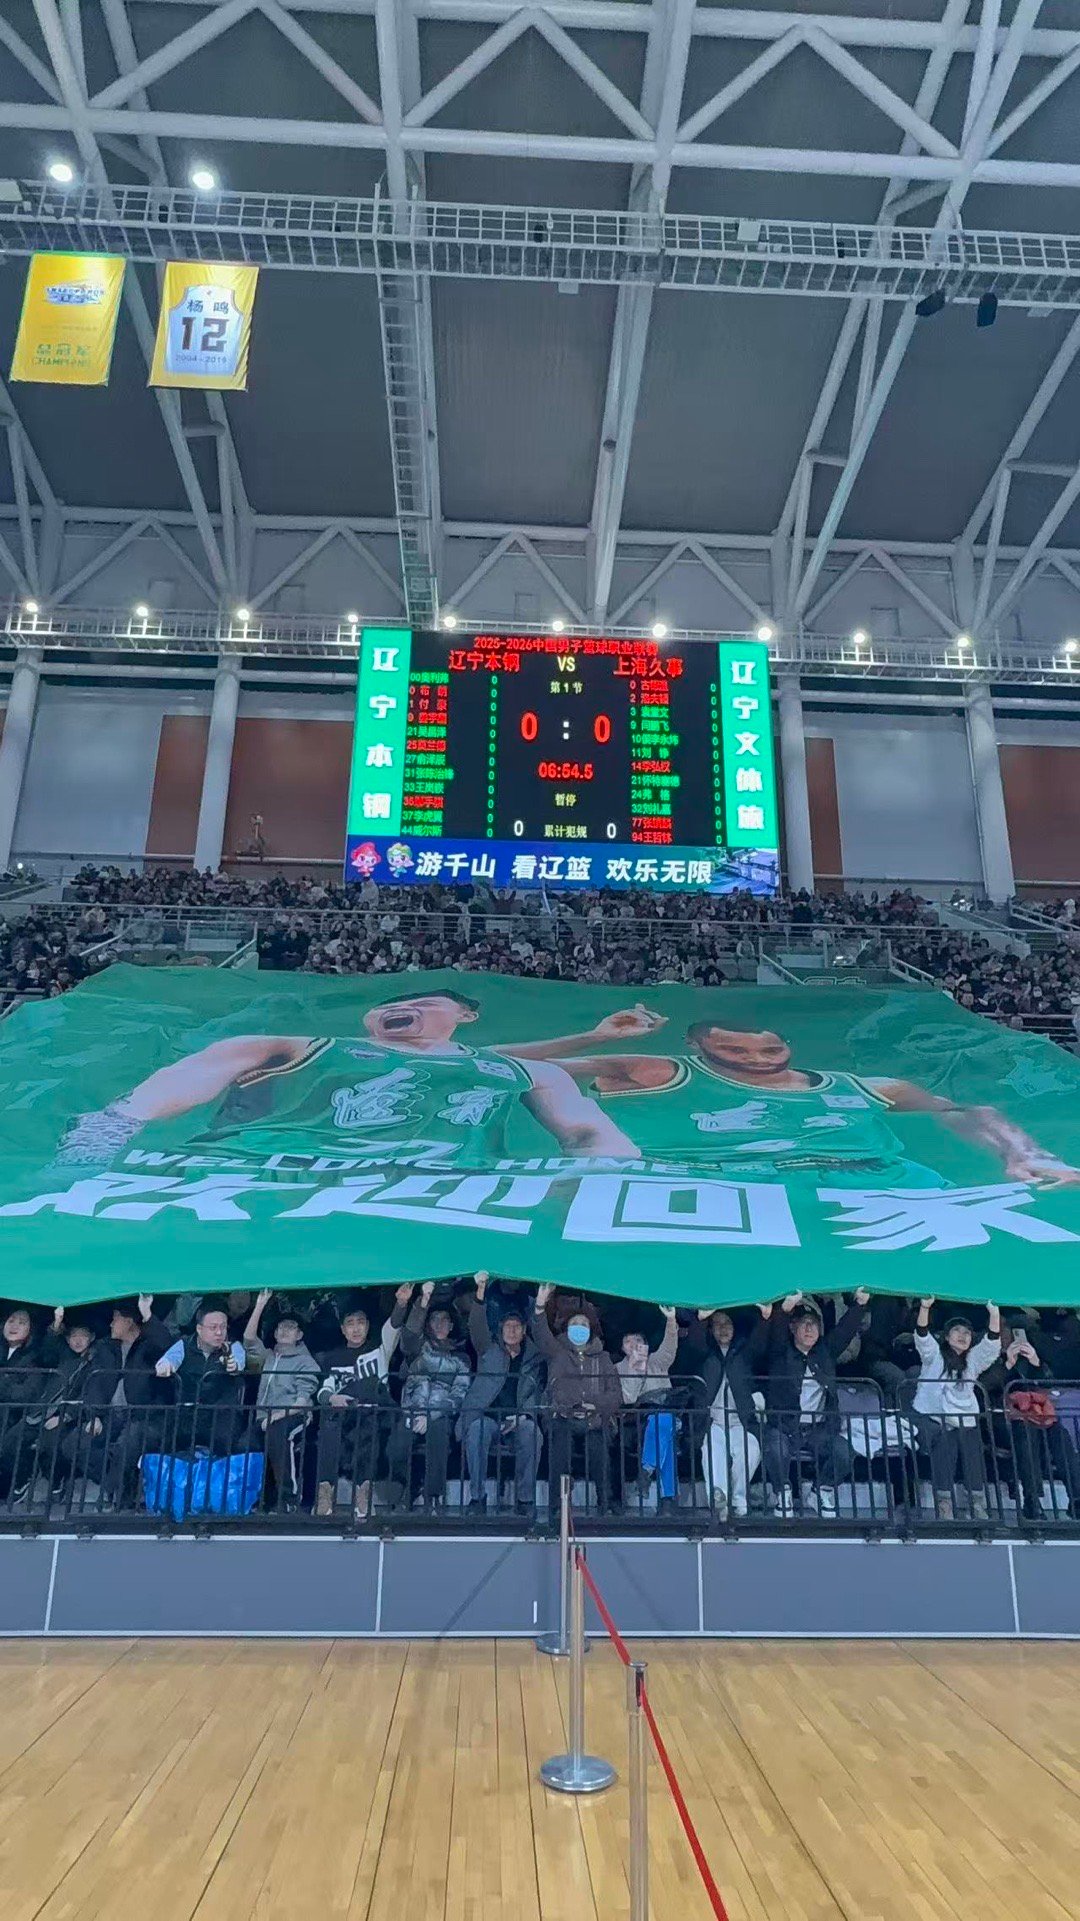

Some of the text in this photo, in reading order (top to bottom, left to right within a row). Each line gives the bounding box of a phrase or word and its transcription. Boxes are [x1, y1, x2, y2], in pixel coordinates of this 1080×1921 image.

[182, 317, 229, 352] 12
[449, 650, 683, 678] 辽宁本钢 VS 上海久事
[492, 676, 498, 685] 0
[629, 680, 636, 690] 0
[710, 683, 716, 692] 0
[409, 685, 416, 695] 0
[491, 689, 497, 698] 0
[629, 693, 636, 703] 2
[711, 696, 717, 705] 0
[490, 702, 496, 711] 0
[630, 707, 637, 716] 3
[711, 710, 718, 719] 0
[490, 716, 496, 725] 0
[520, 711, 539, 741] 0
[594, 714, 611, 743] 0
[630, 720, 637, 730] 9
[712, 723, 718, 733] 0
[490, 729, 496, 739] 0
[712, 736, 719, 746] 0
[489, 743, 496, 753] 0
[713, 750, 719, 760] 0
[489, 757, 495, 766] 0
[538, 762, 594, 779] 06:54.5
[713, 764, 720, 773] 0
[488, 771, 494, 780] 0
[714, 777, 720, 787] 0
[488, 785, 494, 794] 0
[555, 793, 577, 807] 暂停
[714, 792, 721, 801] 0
[488, 799, 494, 808] 0
[715, 806, 721, 815] 0
[487, 814, 493, 823] 0
[514, 820, 524, 836] 0
[606, 823, 617, 839] 0
[715, 820, 722, 830] 0
[487, 828, 493, 837] 0
[716, 835, 722, 844] 0
[415, 852, 712, 884] 游千山 看辽篮 欢乐无限
[123, 1150, 452, 1171] WELCOME
[500, 1157, 688, 1175] HOME
